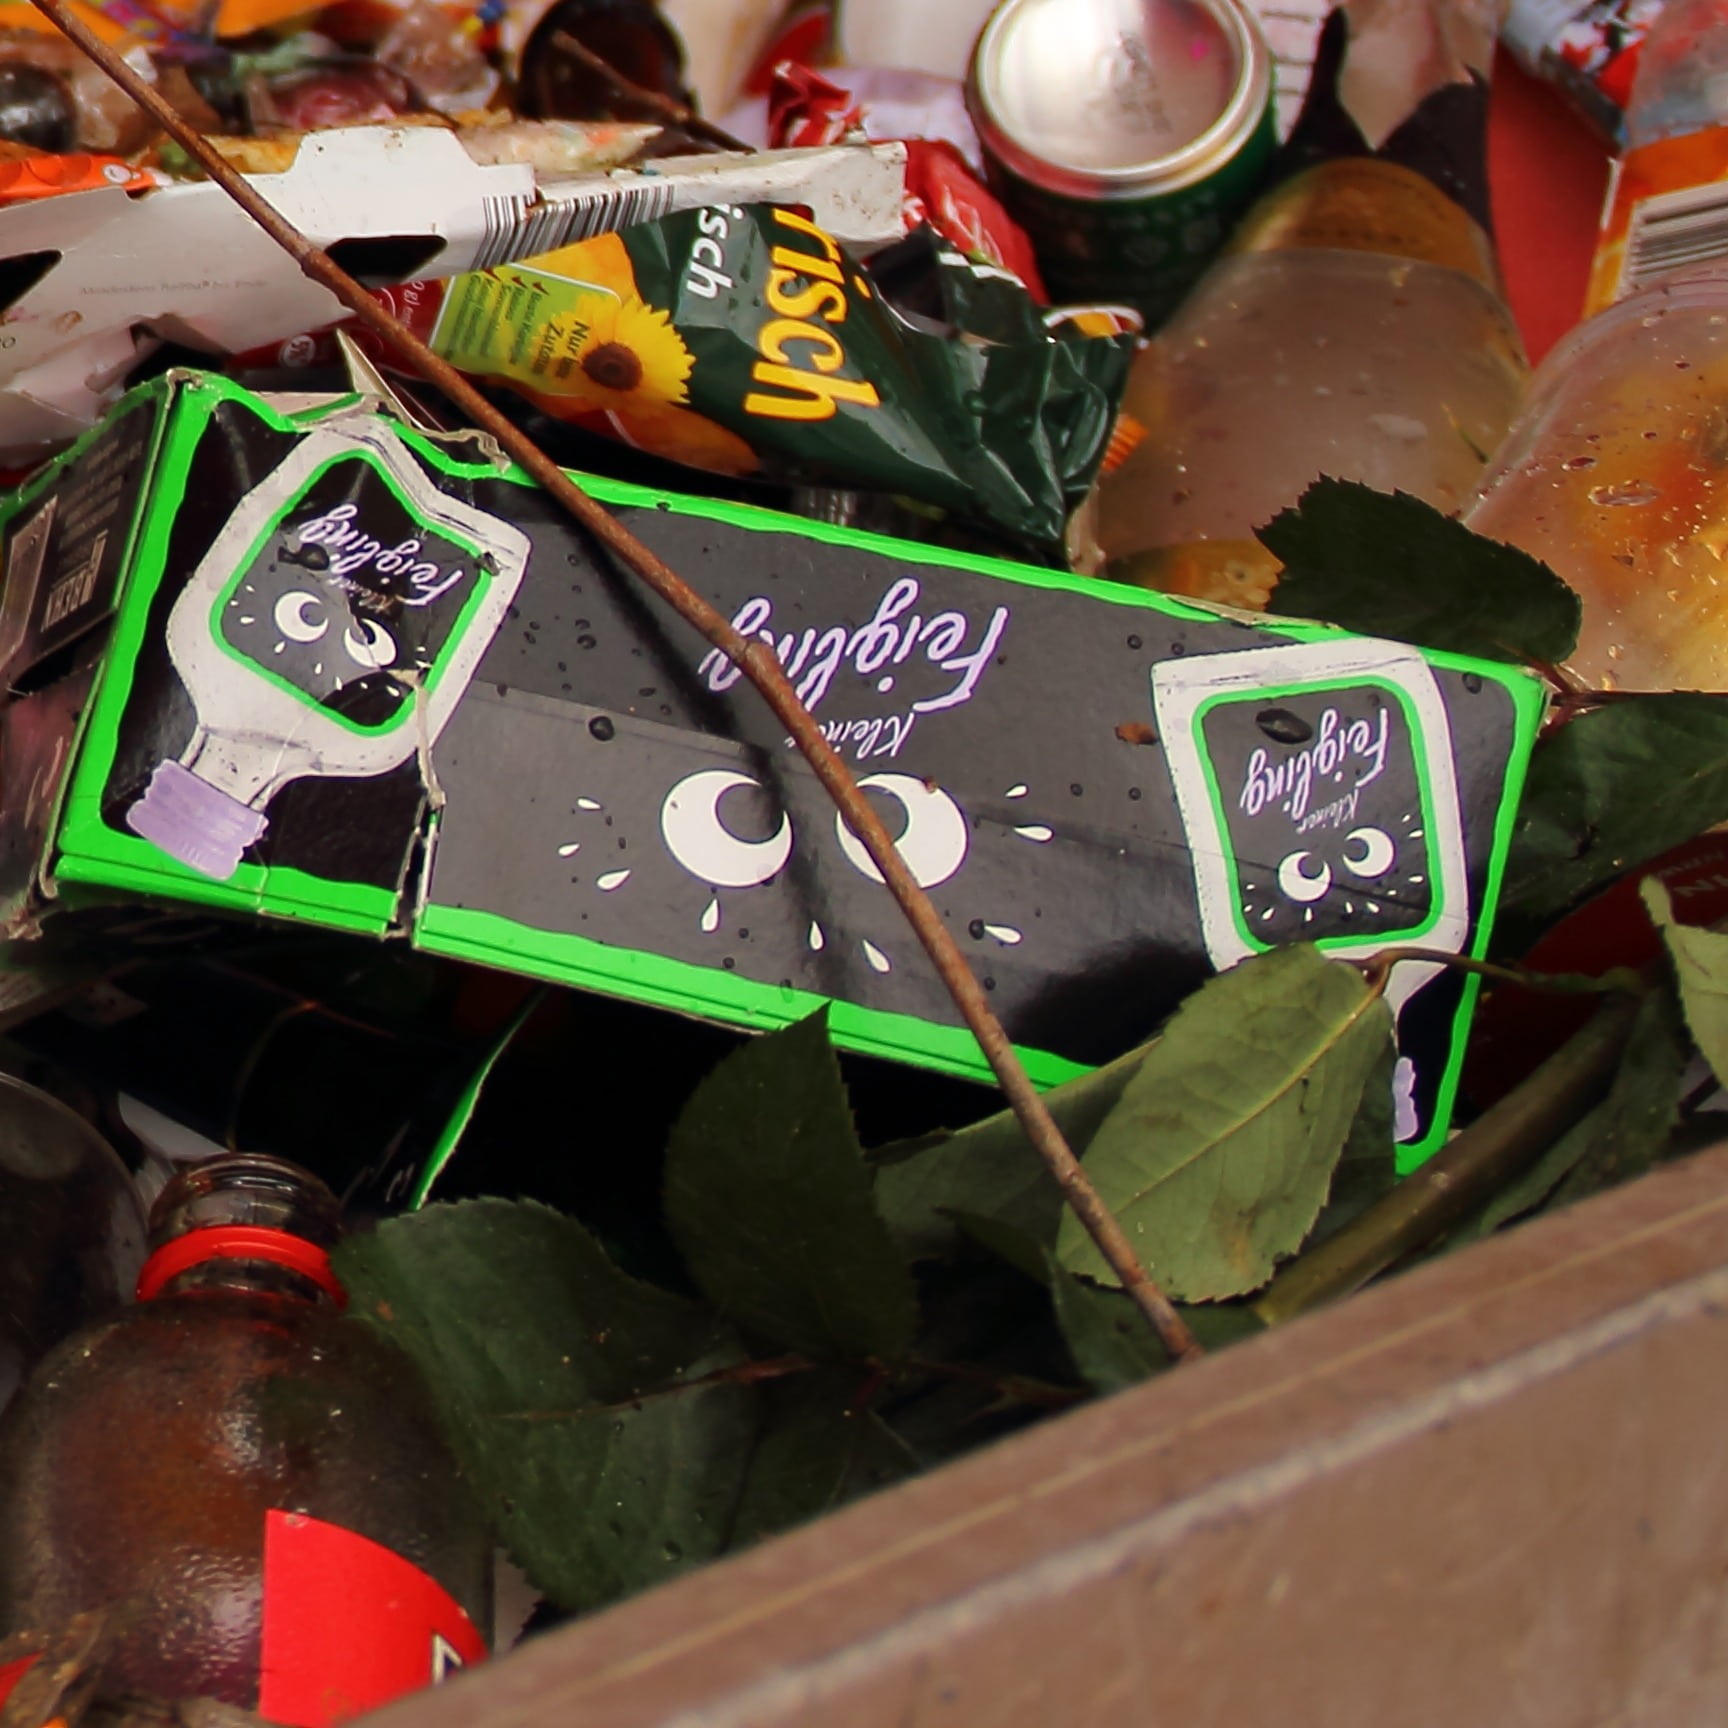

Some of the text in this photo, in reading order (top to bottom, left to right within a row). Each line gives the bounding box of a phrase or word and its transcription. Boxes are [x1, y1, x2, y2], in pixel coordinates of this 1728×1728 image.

[565, 320, 591, 356] Nur
[299, 502, 461, 601] Feigling
[1241, 707, 1386, 821] Feigling
[1294, 789, 1357, 833] Kleiner
